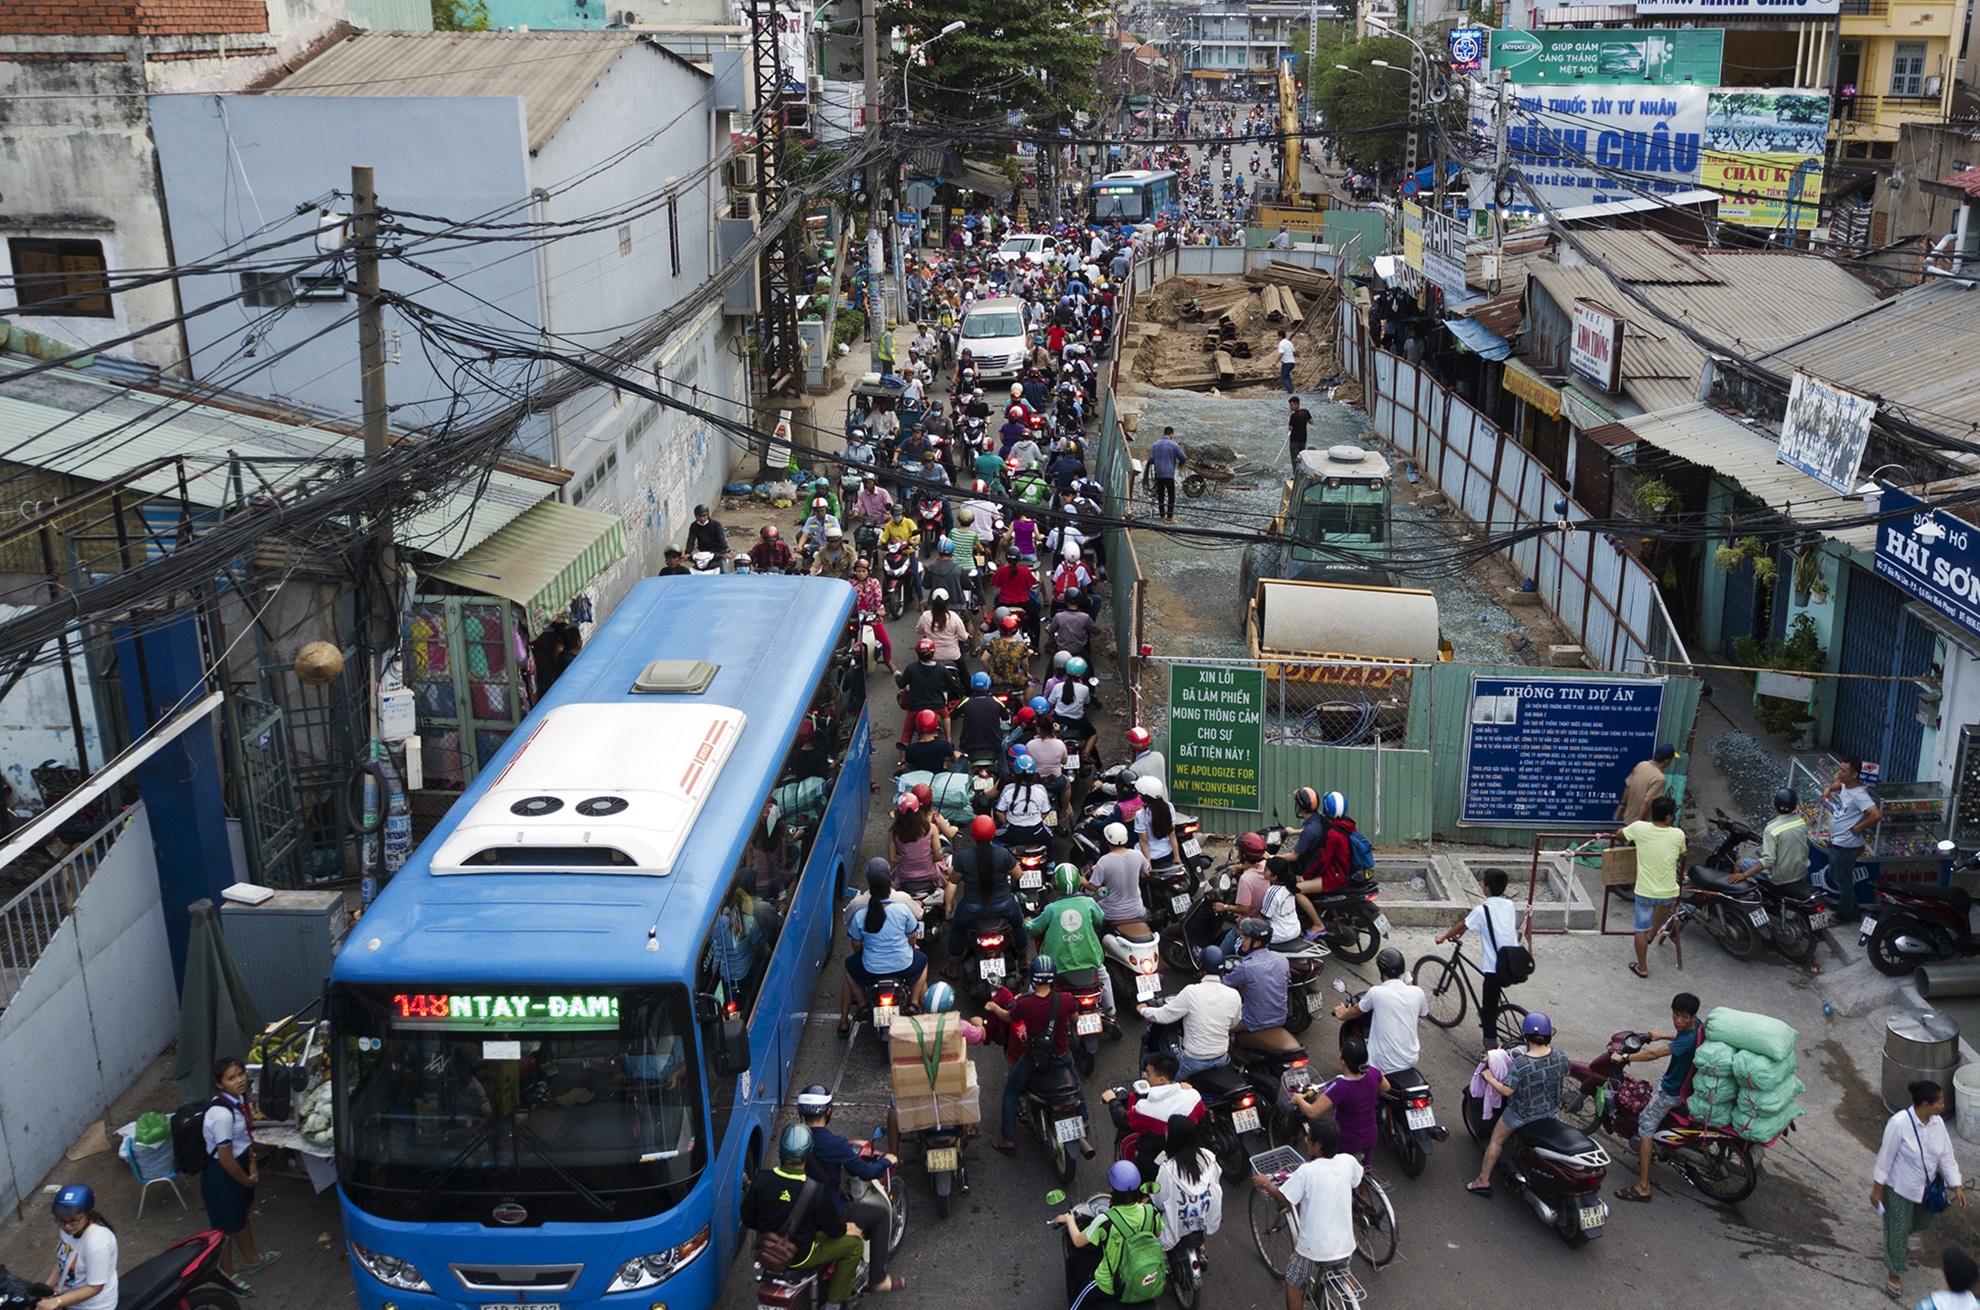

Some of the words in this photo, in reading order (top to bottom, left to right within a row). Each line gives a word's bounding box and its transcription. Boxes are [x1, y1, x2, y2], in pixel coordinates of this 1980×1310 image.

[1501, 43, 1532, 51] Berocca
[1551, 41, 1574, 51] GIÚP
[1576, 41, 1599, 51] GIẢM
[1538, 53, 1564, 63] CĂNG
[1559, 64, 1577, 75] MỆT
[1518, 96, 1543, 113] NHÀ
[1549, 95, 1586, 114] THUỐC
[1592, 97, 1613, 115] TÂY
[1618, 98, 1635, 115] TƯ
[1639, 97, 1677, 116] NHÂN
[1597, 121, 1699, 173] CHÂU
[1723, 163, 1769, 182] CHÂU
[1913, 512, 1947, 540] ĐỒG
[1949, 529, 1968, 551] HỒ
[1886, 527, 1930, 575] HẢI
[1199, 670, 1216, 683] XIN
[1218, 668, 1234, 685] LỖI
[1182, 687, 1195, 701] ĐÃ
[1198, 687, 1218, 702] LÀM
[1221, 688, 1250, 704] PHIỀN
[1503, 684, 1555, 699] THÔNG
[1559, 688, 1584, 700] TIN
[1587, 688, 1610, 704] DỰ
[1613, 686, 1635, 702] ÁN
[1172, 707, 1200, 720] MONG
[1203, 708, 1236, 723] THÔNG
[1238, 708, 1259, 724] CẢM
[1197, 727, 1217, 740] CHO
[1219, 729, 1233, 744] SỰ
[1180, 742, 1198, 757] BẤT
[1200, 746, 1222, 761] TIỆN
[1225, 745, 1243, 761] NÀY
[1246, 749, 1250, 761] !
[1176, 764, 1188, 775] WE
[1190, 765, 1235, 779] APOLOGIZE
[1237, 768, 1255, 780] FOR
[1173, 780, 1189, 791] ANY
[1191, 780, 1257, 796] INCONVENIENCE
[1197, 797, 1228, 808] CAUSED
[1923, 871, 1938, 883] SƠN
[1062, 932, 1084, 943] Grab
[393, 994, 450, 1017] 148
[1060, 1127, 1082, 1141] 0629
